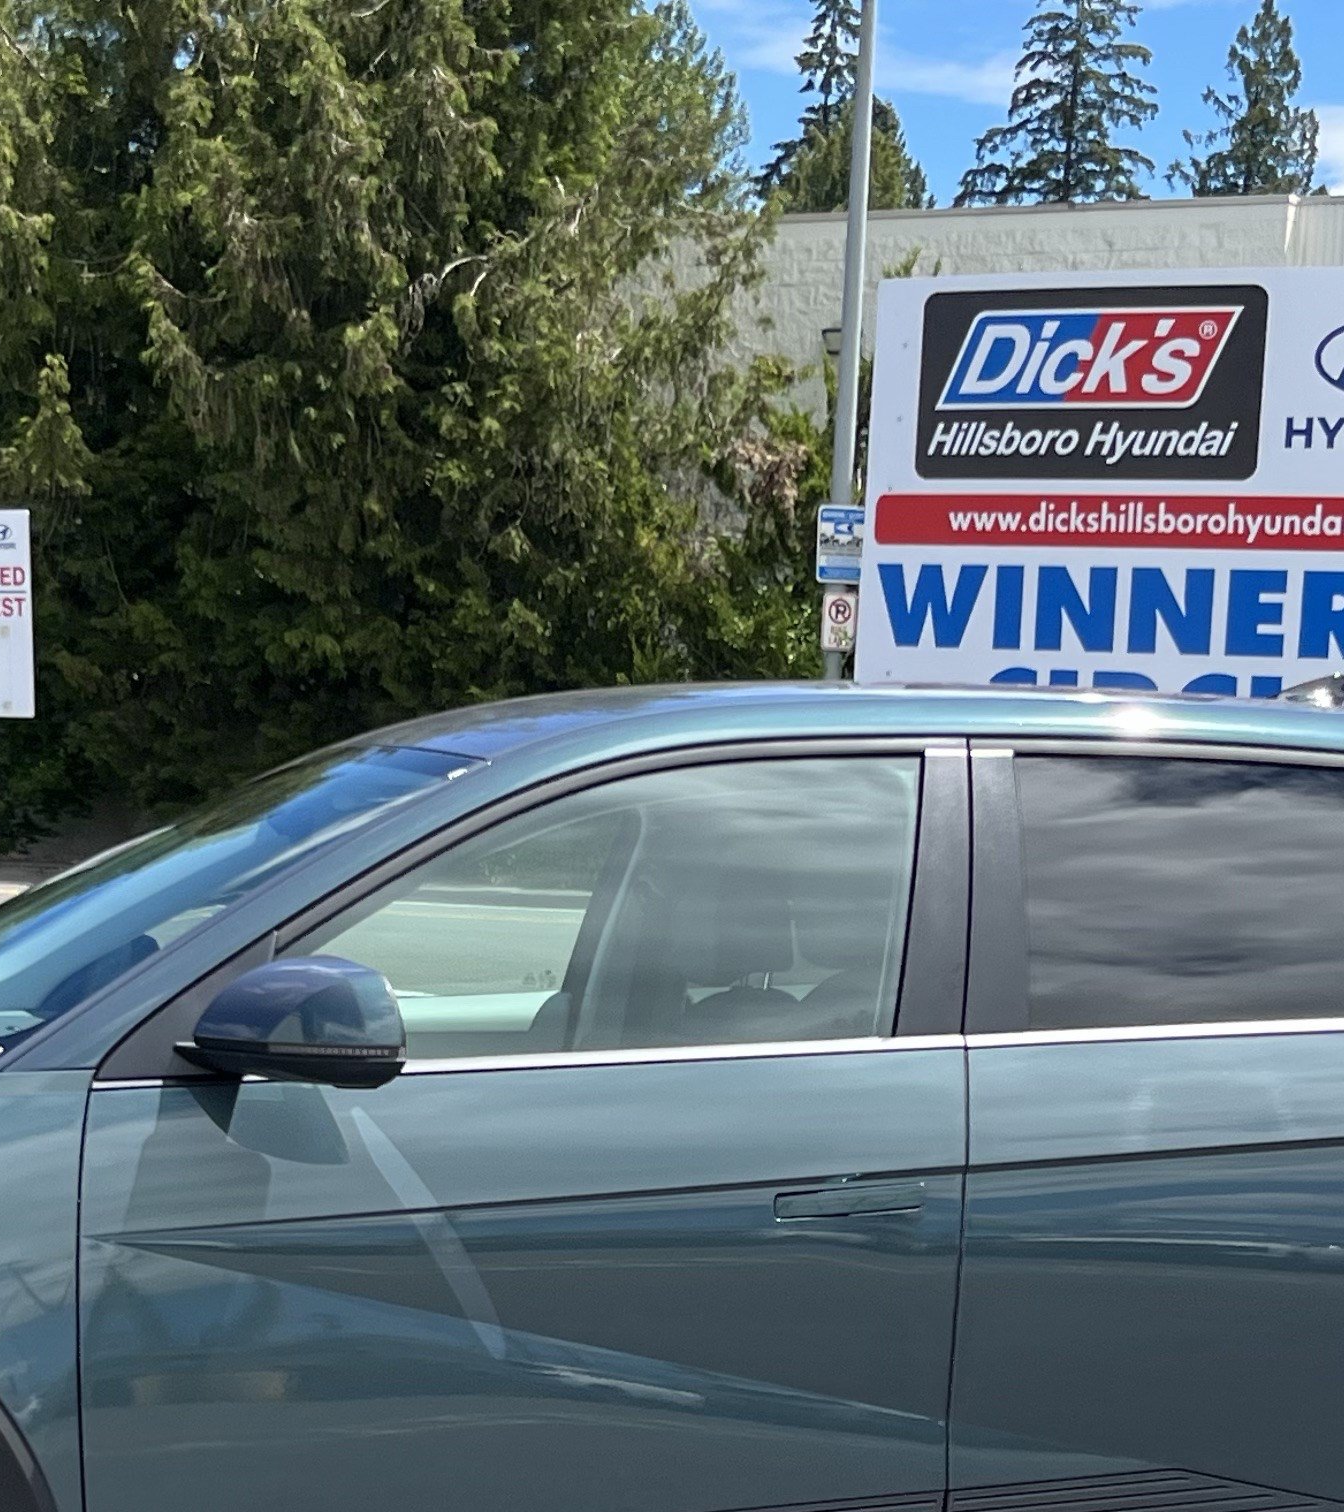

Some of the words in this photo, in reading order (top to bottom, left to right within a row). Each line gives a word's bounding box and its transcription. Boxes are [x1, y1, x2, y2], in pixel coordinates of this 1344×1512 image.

[958, 318, 1202, 395] Dick's
[927, 420, 1079, 456] Hillsboro
[1083, 420, 1238, 465] Hyundai
